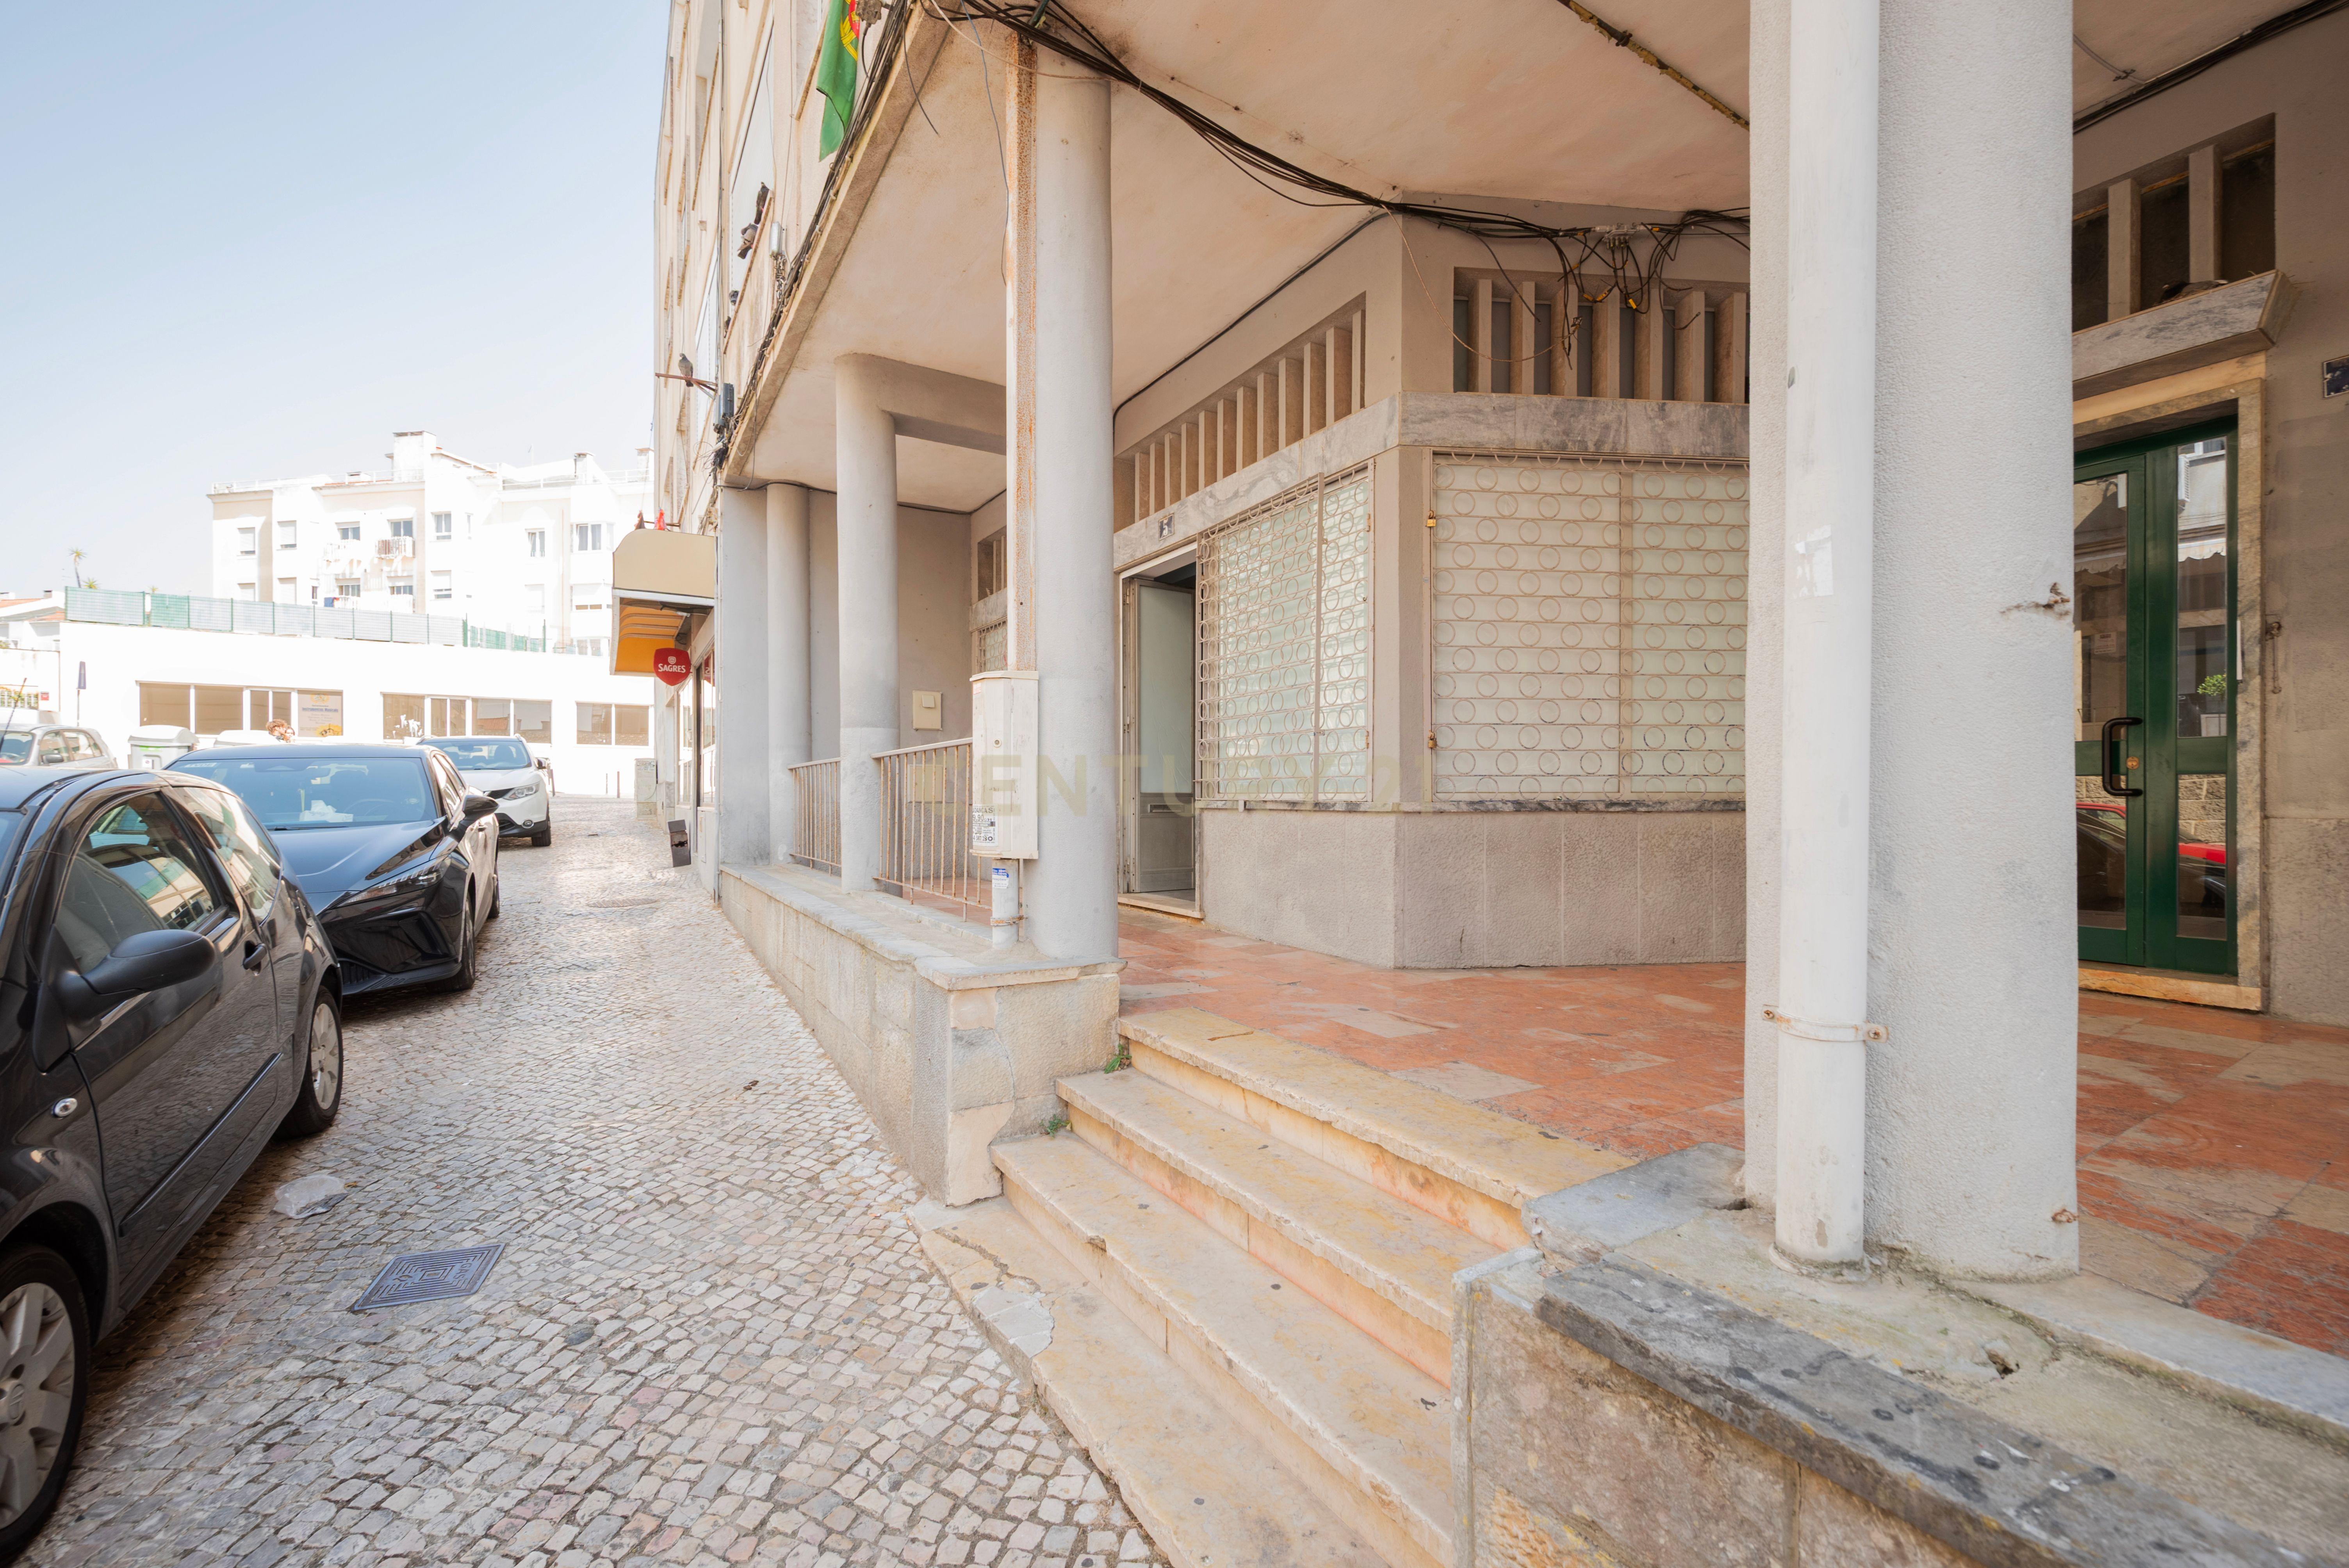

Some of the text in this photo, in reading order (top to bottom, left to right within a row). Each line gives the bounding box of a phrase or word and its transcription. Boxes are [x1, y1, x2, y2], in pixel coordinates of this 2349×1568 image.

[1161, 518, 1168, 538] 5
[658, 663, 686, 673] SAGRES
[453, 1263, 472, 1279] GAS
